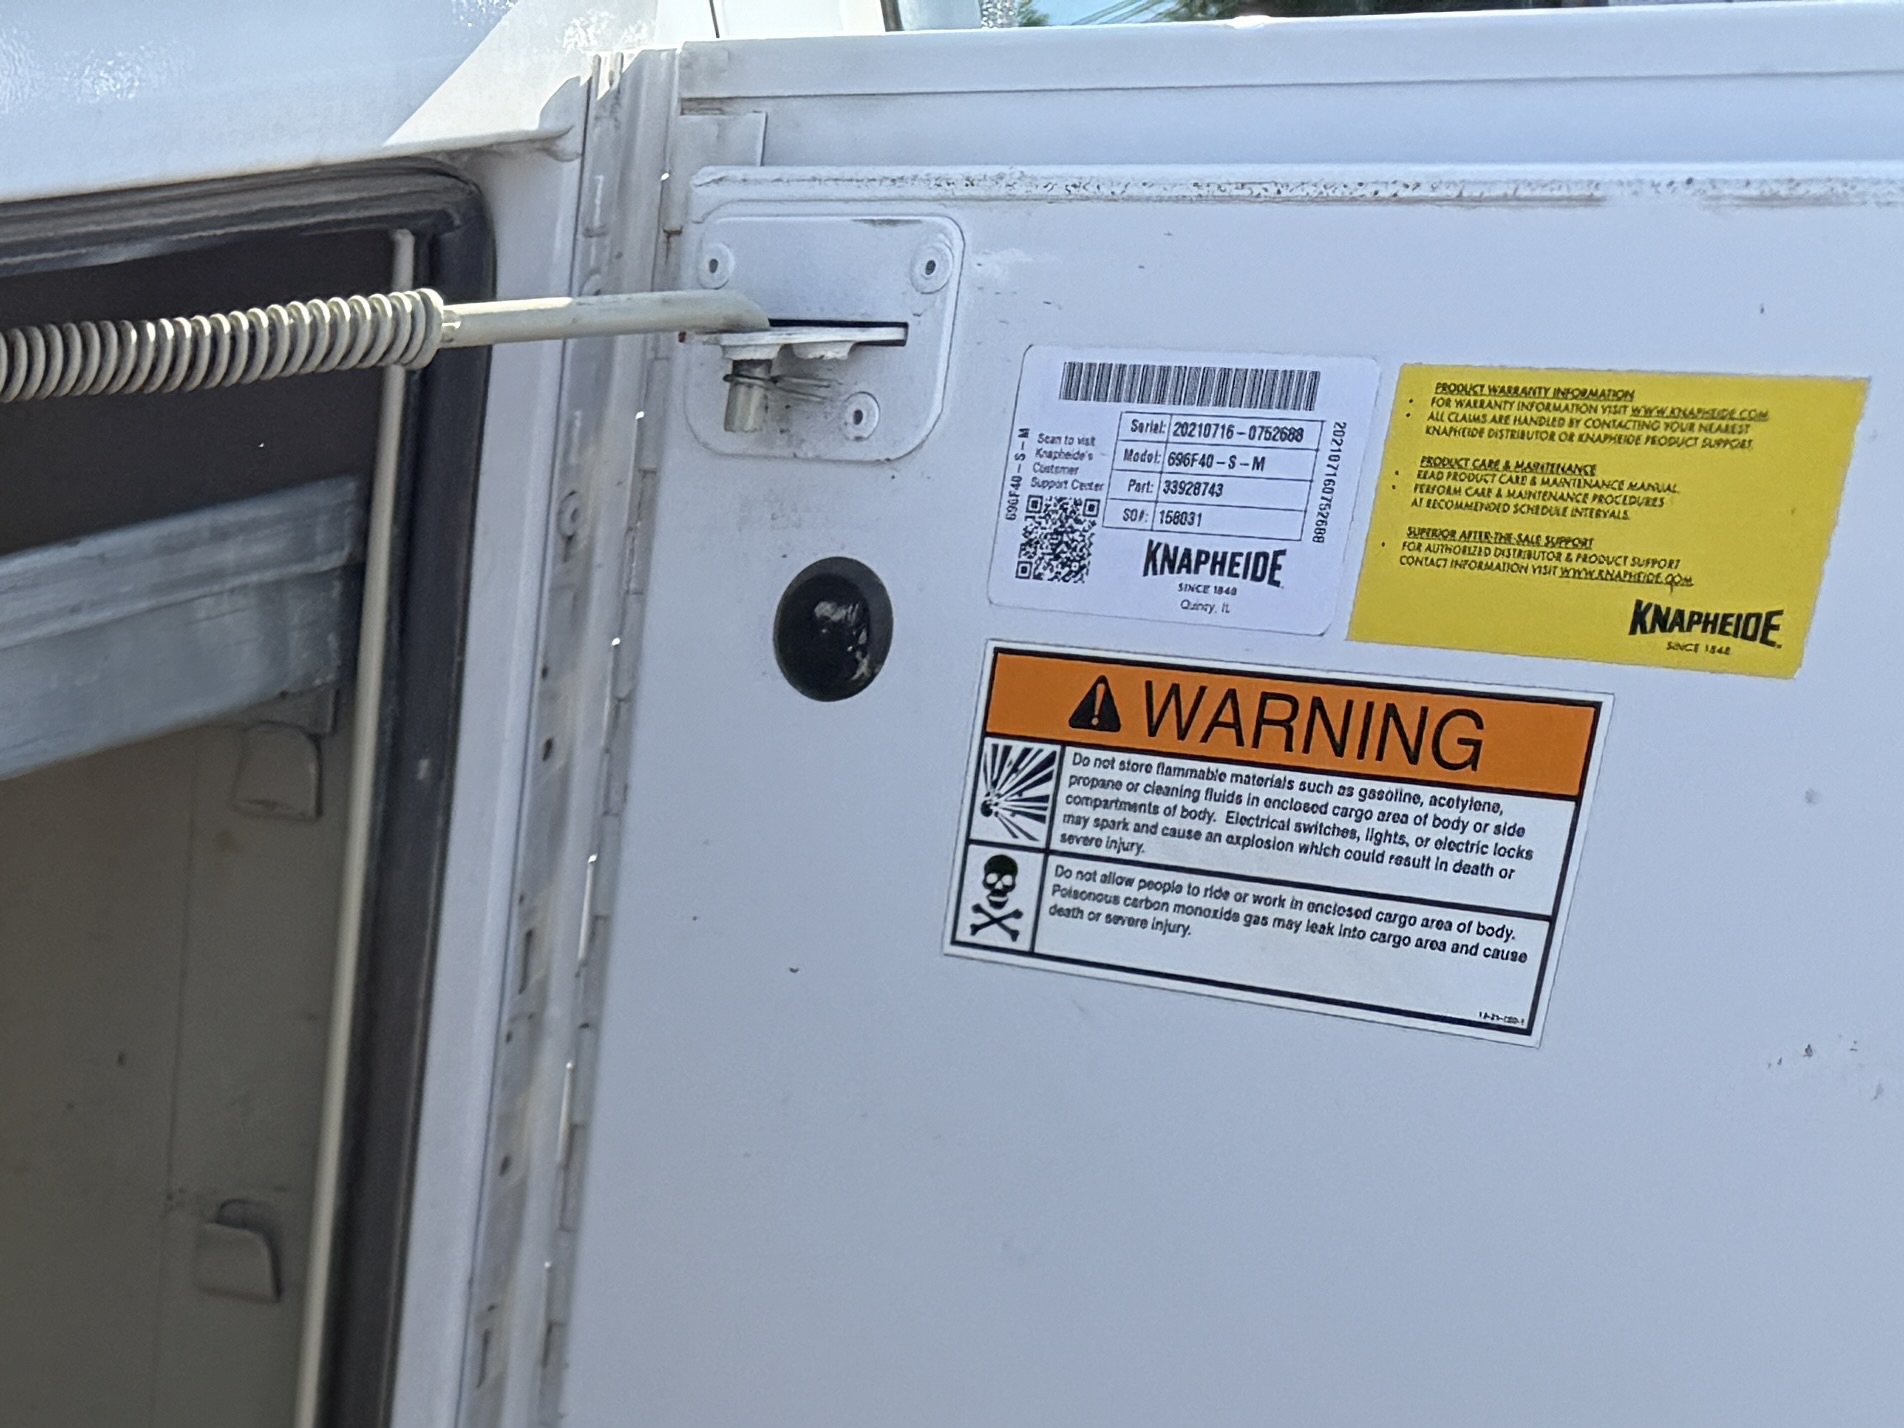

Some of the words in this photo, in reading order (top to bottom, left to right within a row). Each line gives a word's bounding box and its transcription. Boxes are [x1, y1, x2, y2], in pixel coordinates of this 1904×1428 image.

[1434, 381, 1485, 397] PRODUCT
[1485, 384, 1550, 399] WARRANTY
[1550, 386, 1636, 402] INFORMATION
[1430, 396, 1452, 409] FOR
[1454, 398, 1516, 411] WARRANTY
[1516, 400, 1599, 415] INFORMATION
[1600, 404, 1629, 416] VISIT
[1130, 418, 1167, 435] Serial:
[1426, 411, 1445, 423] ALL
[1447, 411, 1488, 425] CLAIMS
[1487, 414, 1511, 426] ARE
[1512, 415, 1566, 428] HANDLED
[1567, 417, 1582, 429] BY
[1583, 417, 1661, 432] CONTACTING
[1663, 420, 1696, 434] YOUR
[1697, 422, 1751, 436] NEAREST
[1036, 432, 1062, 445] Scan
[1063, 435, 1075, 446] to
[1077, 435, 1096, 447] visit
[1424, 424, 1485, 439] KNAPHEIDE
[1487, 427, 1556, 442] DISTRIBUTOR
[1558, 431, 1576, 443] OR
[1577, 432, 1642, 447] KNAPHEIDE
[1643, 434, 1700, 449] PRODUCT
[1034, 447, 1094, 461] Knapheide's
[1122, 448, 1162, 464] Model:
[1419, 455, 1470, 471] PRODUCT
[1470, 458, 1500, 472] CARE
[1511, 460, 1597, 477] MAINTENANCE
[1032, 461, 1080, 476] Customer
[1416, 469, 1445, 482] READ
[1445, 470, 1497, 485] PRODUCT
[1497, 473, 1528, 486] CARE
[1539, 476, 1625, 492] MAINTENANCE
[1030, 476, 1069, 491] Support
[1070, 478, 1105, 492] Center
[1127, 478, 1154, 494] Part:
[1162, 479, 1224, 498] 33928743
[1413, 482, 1462, 497] PERFORM
[1464, 486, 1493, 499] CARE
[1505, 488, 1590, 505] MAINTENANCE
[1590, 492, 1665, 508] PROCEDURES
[1410, 497, 1424, 508] AT
[1425, 498, 1511, 514] RECOMMENDED
[1512, 503, 1569, 518] SCHEDULE
[1406, 526, 1457, 542] SUPERIOR
[1542, 535, 1595, 551] SUPPORT
[1142, 538, 1288, 588] KNAPHEIDE
[1399, 554, 1449, 569] CONTACT
[1449, 558, 1529, 575] INFORMATION
[1531, 564, 1559, 577] VISIT
[1401, 540, 1423, 553] FOR
[1424, 543, 1492, 558] AUTHORIZED
[1493, 546, 1563, 563] DISTRIBUTOR
[1574, 552, 1629, 567] PRODUCT
[1629, 556, 1681, 570] SUPPORT
[1177, 582, 1211, 595] SINCE
[1628, 599, 1784, 648] KNAPHEIDE
[1665, 641, 1700, 654] SINCE
[1144, 679, 1485, 772] WARNING
[1071, 751, 1091, 768] Do
[1093, 756, 1116, 770] not
[1118, 759, 1154, 774] store
[1155, 761, 1228, 783] flammable
[1229, 772, 1295, 791] materials
[1298, 780, 1334, 795] such
[1336, 784, 1355, 798] as
[1357, 787, 1424, 808] gasoline,
[1428, 794, 1504, 817] acetylene,
[1067, 774, 1123, 792] propane
[1125, 781, 1141, 793] or
[1142, 780, 1201, 804] cleaning
[1204, 787, 1243, 806] fluids
[1246, 792, 1260, 808] in
[1263, 797, 1330, 816] enclosed
[1331, 805, 1374, 824] cargo
[1376, 810, 1409, 825] area
[1413, 812, 1429, 827] of
[1431, 813, 1470, 835] body
[1472, 821, 1491, 834] or
[1492, 821, 1526, 838] side
[1065, 794, 1160, 816] compartments
[1162, 803, 1178, 818] of
[1179, 804, 1217, 825] body.
[1224, 810, 1291, 832] Electrical
[1293, 820, 1361, 843] switches,
[1364, 827, 1410, 848] lights,
[1414, 836, 1432, 848] or
[1434, 835, 1489, 856] electric
[1492, 842, 1534, 861] locks
[1059, 832, 1104, 849] severe
[1105, 835, 1145, 857] injury.
[1062, 813, 1090, 830] may
[1093, 817, 1130, 832] spark
[1132, 821, 1159, 836] and
[1160, 825, 1203, 841] cause
[1204, 831, 1223, 844] an
[1225, 833, 1295, 853] explosion
[1298, 840, 1341, 859] which
[1343, 848, 1386, 865] could
[1388, 854, 1432, 870] result
[1434, 855, 1449, 873] in
[1452, 858, 1495, 878] death
[1498, 867, 1516, 880] or
[1054, 864, 1073, 880] Do
[1075, 869, 1098, 883] not
[1099, 871, 1136, 888] allow
[1136, 878, 1184, 896] people
[1186, 882, 1201, 897] to
[1202, 884, 1231, 901] ride
[1233, 891, 1250, 904] or
[1252, 893, 1287, 909] work
[1289, 896, 1304, 911] in
[1306, 901, 1373, 921] enclosed
[1375, 910, 1418, 929] cargo
[1420, 917, 1453, 932] area
[1456, 920, 1474, 934] of
[1475, 920, 1516, 944] body.
[1048, 903, 1085, 920] death
[1087, 910, 1103, 923] or
[1104, 913, 1149, 930] severe
[1150, 916, 1192, 939] injury.
[1051, 883, 1121, 906] Poisonous
[1123, 896, 1170, 913] carbon
[1172, 903, 1241, 923] monoxide
[1242, 913, 1269, 928] gas
[1272, 917, 1303, 935] may
[1305, 918, 1335, 936] leak
[1337, 923, 1367, 941] into
[1369, 930, 1412, 949] cargo
[1414, 937, 1447, 953] area
[1450, 942, 1480, 957] and
[1482, 946, 1528, 964] cause
